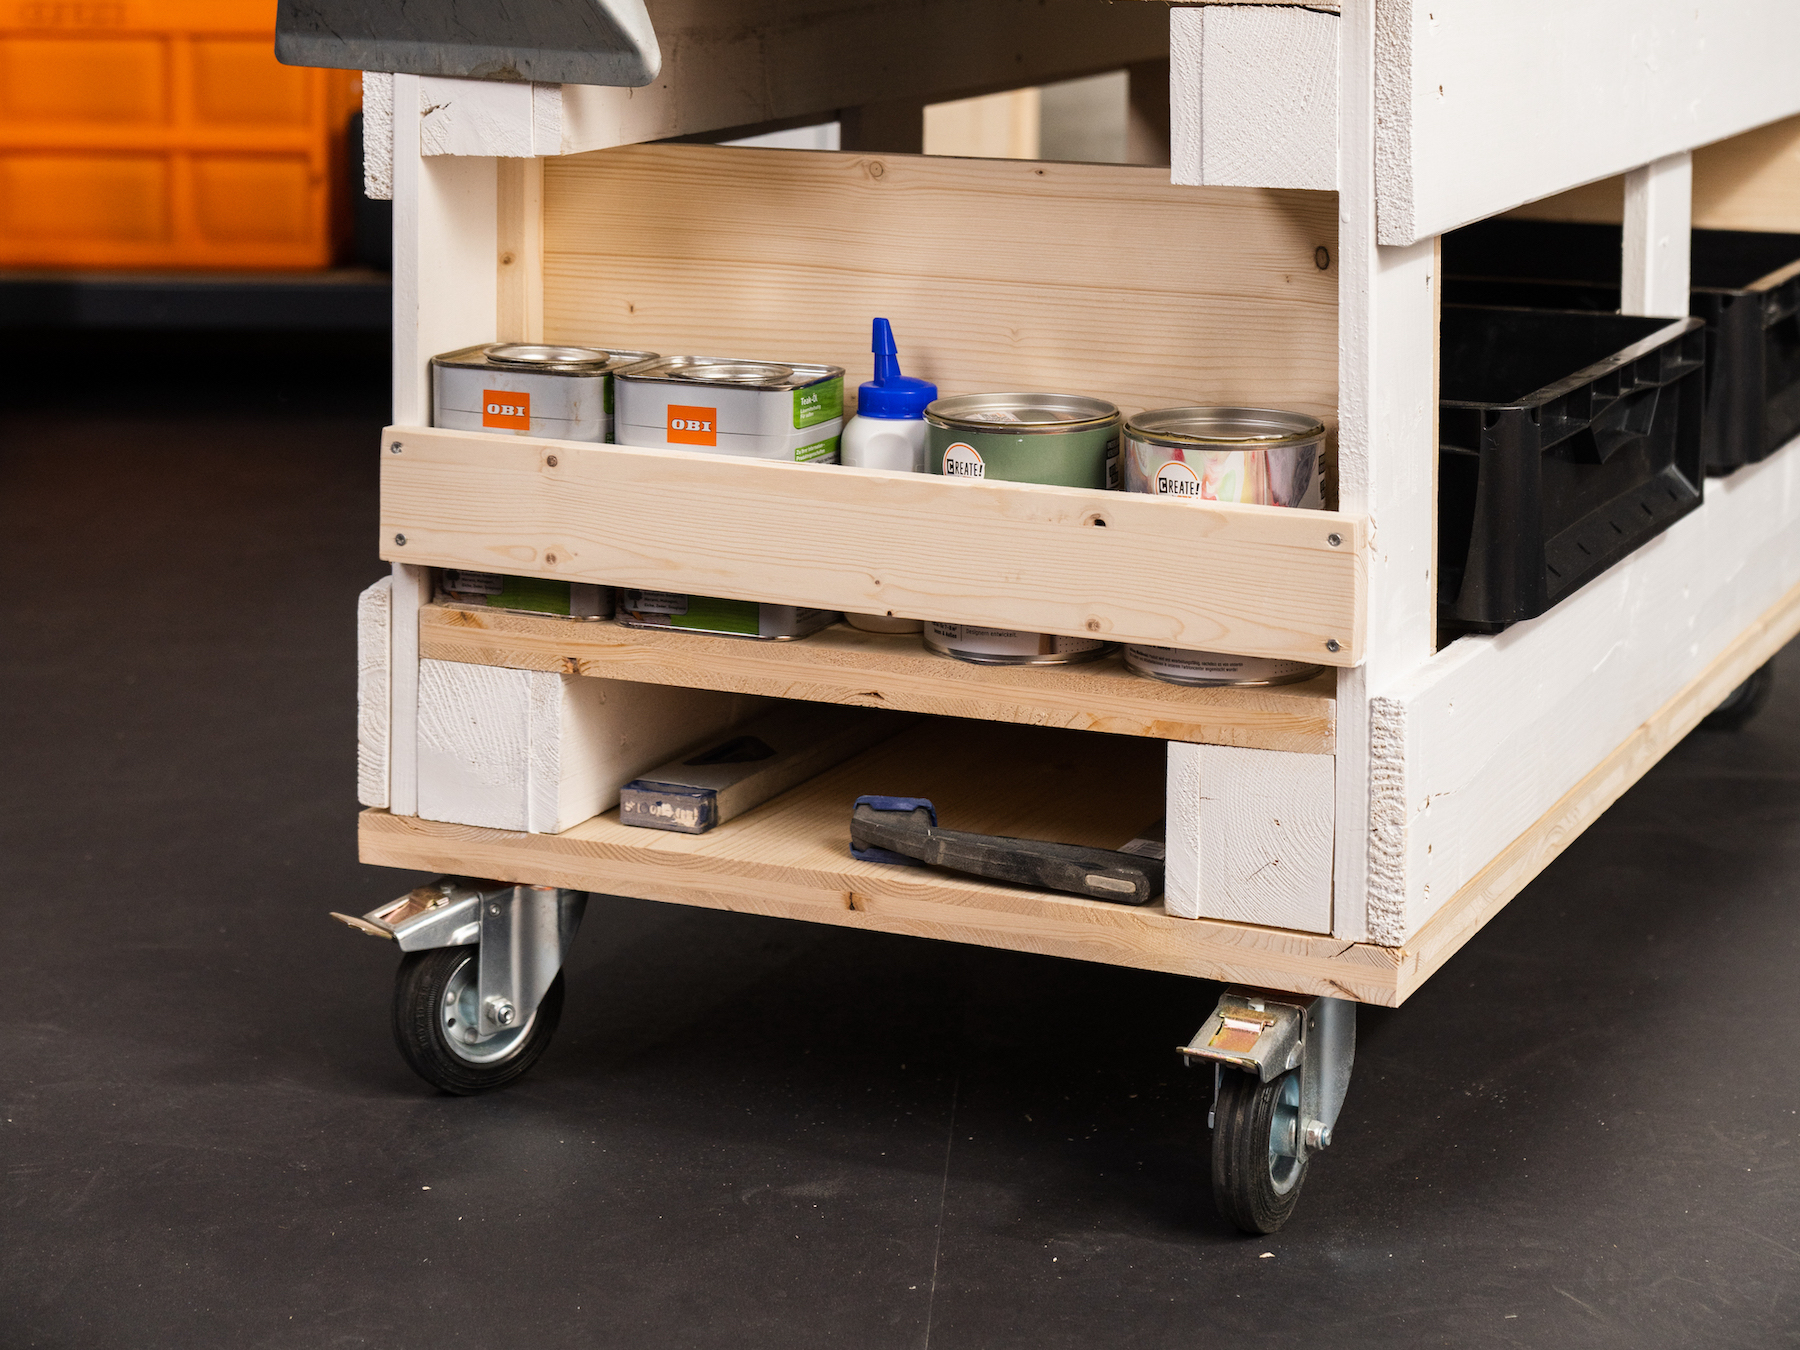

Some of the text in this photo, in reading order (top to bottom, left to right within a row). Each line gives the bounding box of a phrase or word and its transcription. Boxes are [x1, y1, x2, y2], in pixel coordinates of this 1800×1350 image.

[487, 403, 526, 417] OBI
[671, 418, 712, 432] OBI
[946, 459, 983, 477] CREATE!
[1158, 477, 1200, 495] CREATE!
